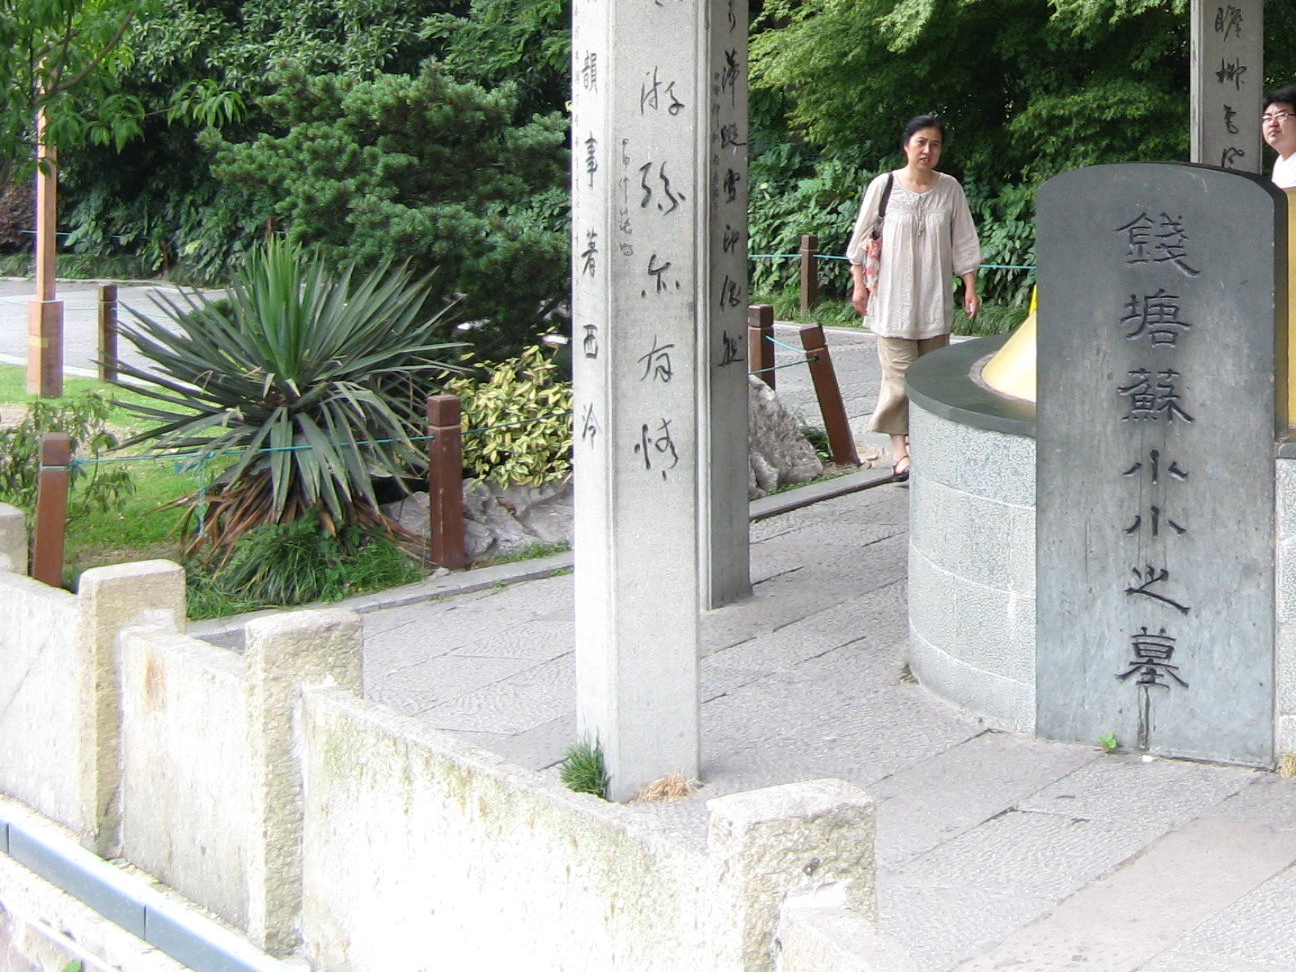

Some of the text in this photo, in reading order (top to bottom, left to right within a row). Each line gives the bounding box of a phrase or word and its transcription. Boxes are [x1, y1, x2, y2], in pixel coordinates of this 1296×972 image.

[1113, 211, 1200, 692] 錢塘蘇小小之墓
